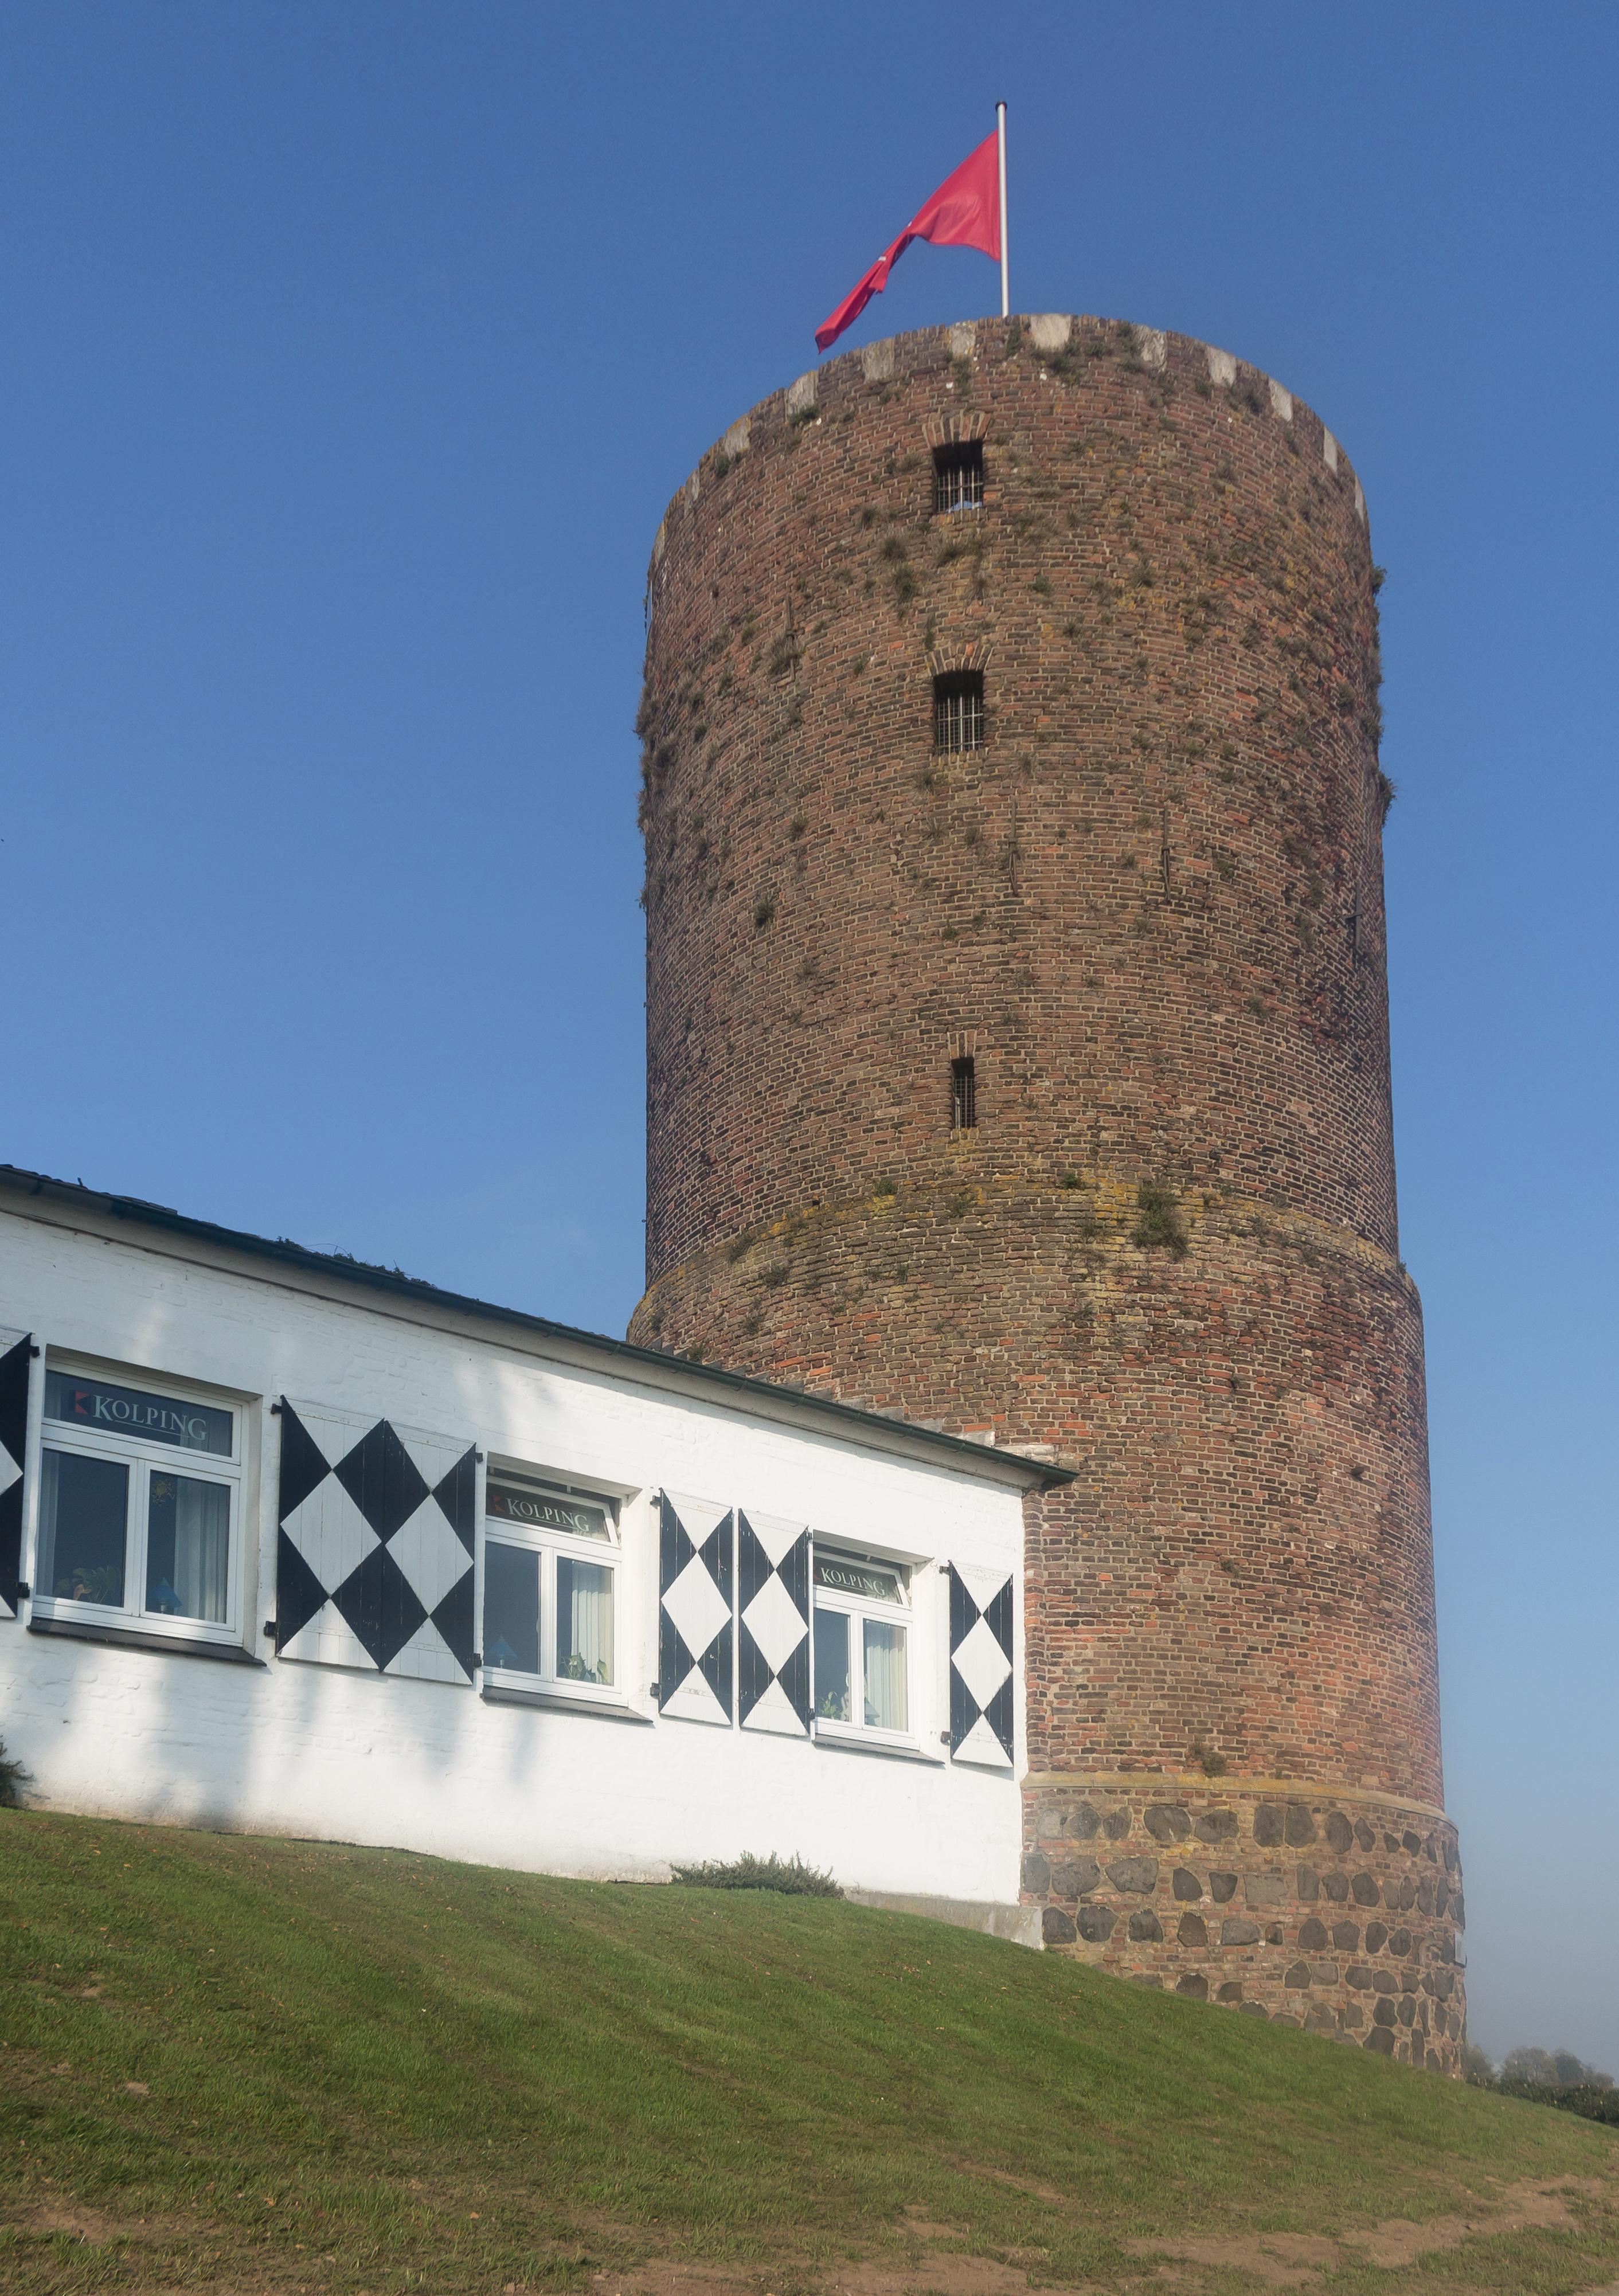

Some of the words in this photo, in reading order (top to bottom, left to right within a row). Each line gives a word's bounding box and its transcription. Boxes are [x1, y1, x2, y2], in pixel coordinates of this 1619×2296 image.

[93, 1395, 207, 1440] KOLPING
[506, 1497, 589, 1532] KOLPING
[820, 1567, 885, 1595] KOLPING
